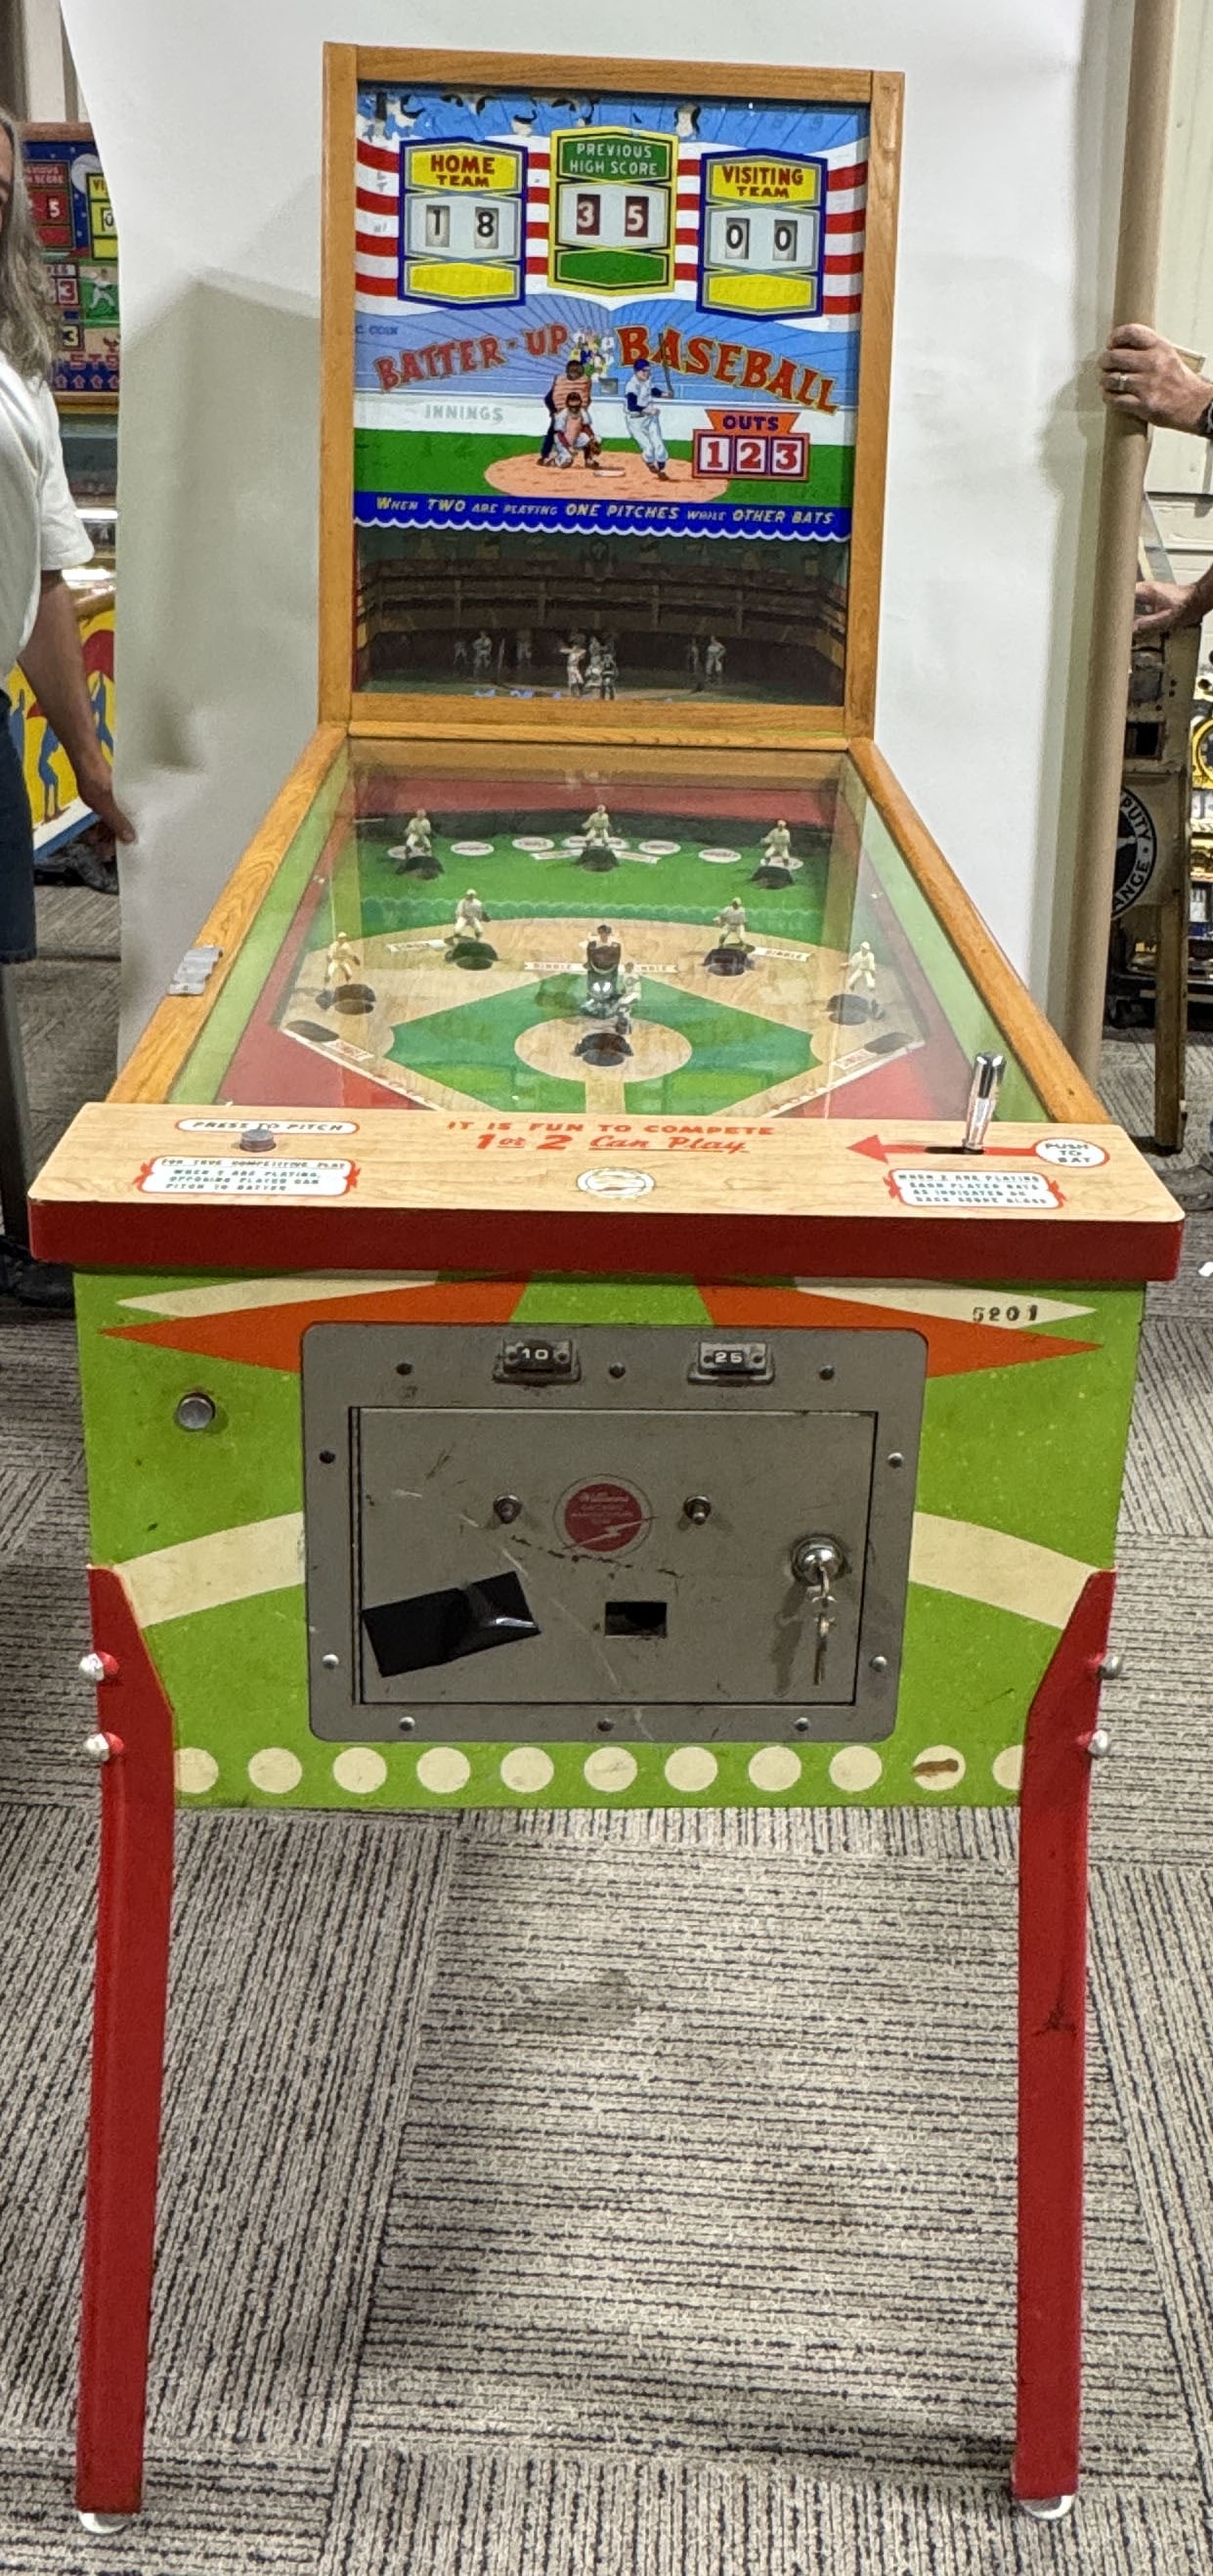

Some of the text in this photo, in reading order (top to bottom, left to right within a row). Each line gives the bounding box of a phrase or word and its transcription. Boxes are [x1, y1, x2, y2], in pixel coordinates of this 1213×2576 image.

[577, 143, 652, 158] PREVIOUS
[430, 154, 496, 175] HOME
[570, 159, 658, 176] HIGH SCORE
[437, 175, 490, 188] TEAM
[722, 165, 803, 186] VISITING
[737, 186, 790, 198] TEAM
[49, 197, 61, 218] 5
[577, 202, 644, 229] 3 5
[431, 208, 495, 239] 1 8
[725, 224, 792, 251] 0 0
[616, 326, 841, 415] BASEBALL
[425, 404, 504, 423] INNINGS
[722, 415, 780, 432] OUTS
[706, 443, 800, 471] 1 2 3
[427, 499, 466, 512] TWO
[471, 502, 499, 514] ARE
[502, 504, 558, 515] PLAYING
[566, 503, 601, 517] ONE
[606, 504, 680, 519] PITCHES
[733, 509, 786, 523] OTHER
[792, 511, 835, 525] BATS
[448, 1121, 775, 1136] IT IS FUN TO COMPETE
[476, 1133, 747, 1154] 1 or 2 Can Play
[521, 1347, 549, 1361] 10
[715, 1351, 744, 1365] 25
